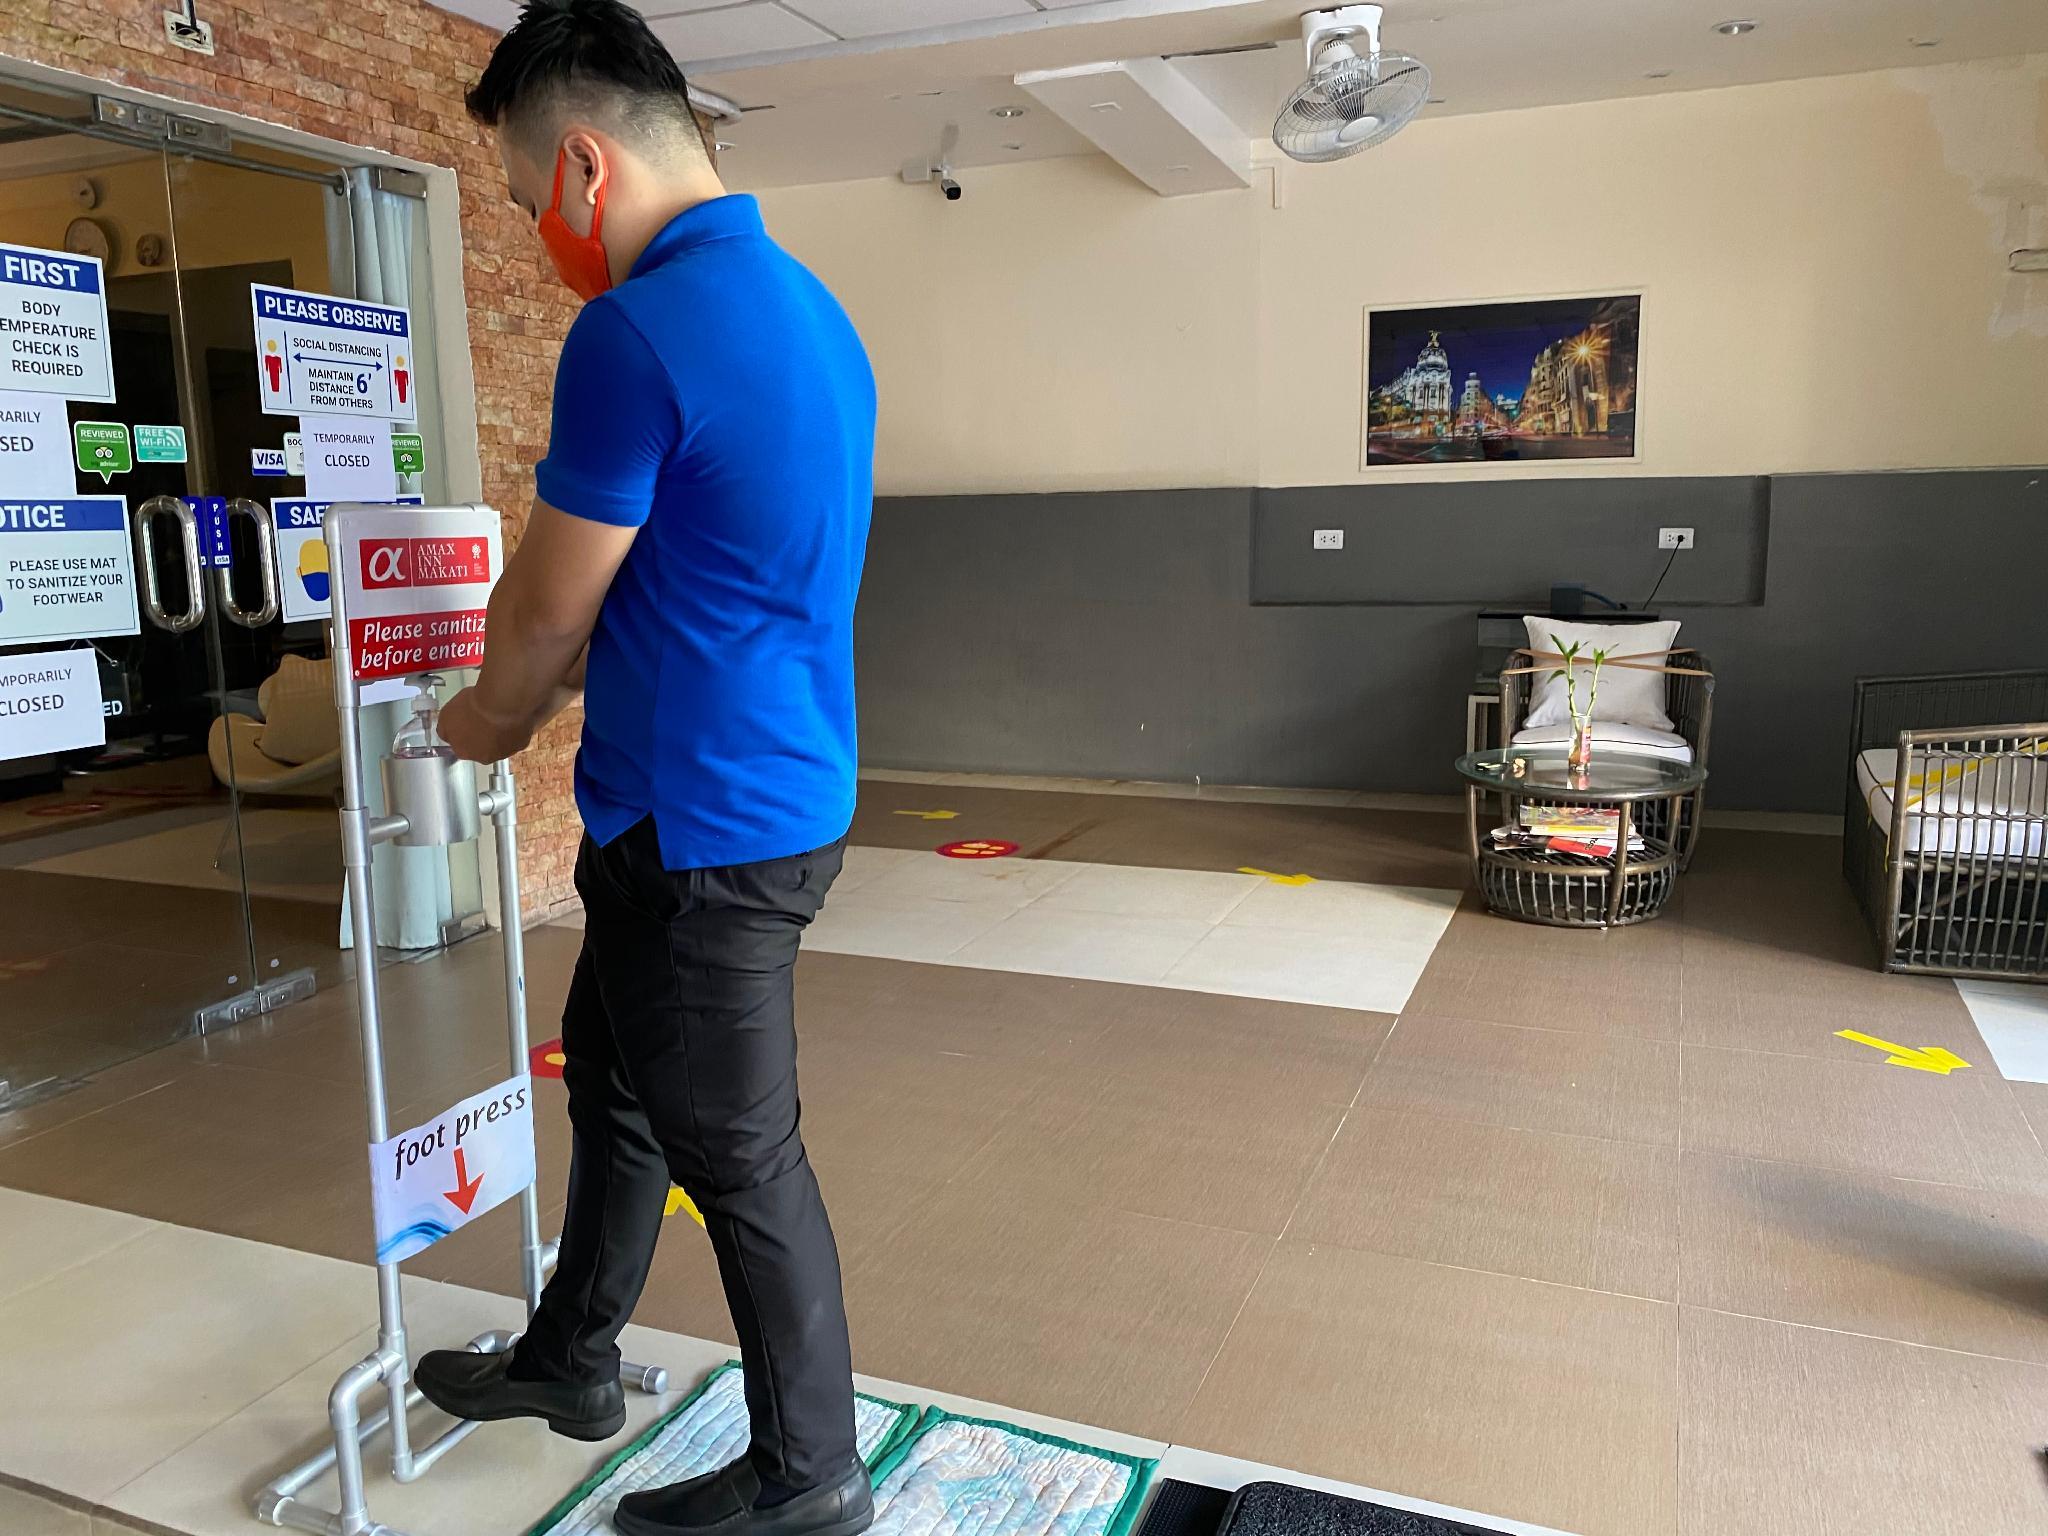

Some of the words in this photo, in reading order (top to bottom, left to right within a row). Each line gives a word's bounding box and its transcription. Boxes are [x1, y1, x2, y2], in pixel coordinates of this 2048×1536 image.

[4, 255, 80, 288] FIRST
[22, 301, 61, 317] BODY
[264, 295, 329, 323] PLEASE
[332, 306, 402, 332] OBSERVE
[0, 318, 97, 341] EMPERATURE
[12, 340, 62, 357] CHECK
[66, 345, 79, 358] IS
[293, 337, 327, 351] SOCIAL
[328, 341, 382, 358] DISTANCING
[12, 360, 84, 377] REQUIRED
[308, 368, 354, 382] MAINTAIN
[309, 381, 354, 395] DISTANCE
[310, 394, 337, 406] FROM
[338, 397, 373, 409] OTHERS
[80, 429, 124, 439] REVIEWED
[139, 428, 164, 437] FREE
[313, 433, 375, 445] TEMPORARILY
[0, 436, 34, 452] SED
[140, 437, 166, 447] WI-FI
[256, 453, 284, 466] VISA
[324, 454, 370, 468] CLOSED
[290, 505, 330, 526] SAF
[212, 503, 224, 552] PUSH
[417, 543, 456, 556] AMAX
[10, 560, 60, 572] PLEASE
[63, 558, 87, 570] USE
[90, 557, 117, 569] MAT
[417, 555, 442, 568] INN
[417, 565, 468, 580] MAKATI
[6, 578, 24, 590] TO
[28, 575, 87, 589] SANITIZE
[90, 573, 123, 585] YOUR
[33, 591, 103, 606] FOOTWEAR
[363, 621, 423, 644] Please
[361, 645, 423, 671] before
[0, 694, 64, 716] CLOSED
[395, 1124, 446, 1181] foot
[455, 1088, 526, 1145] press
